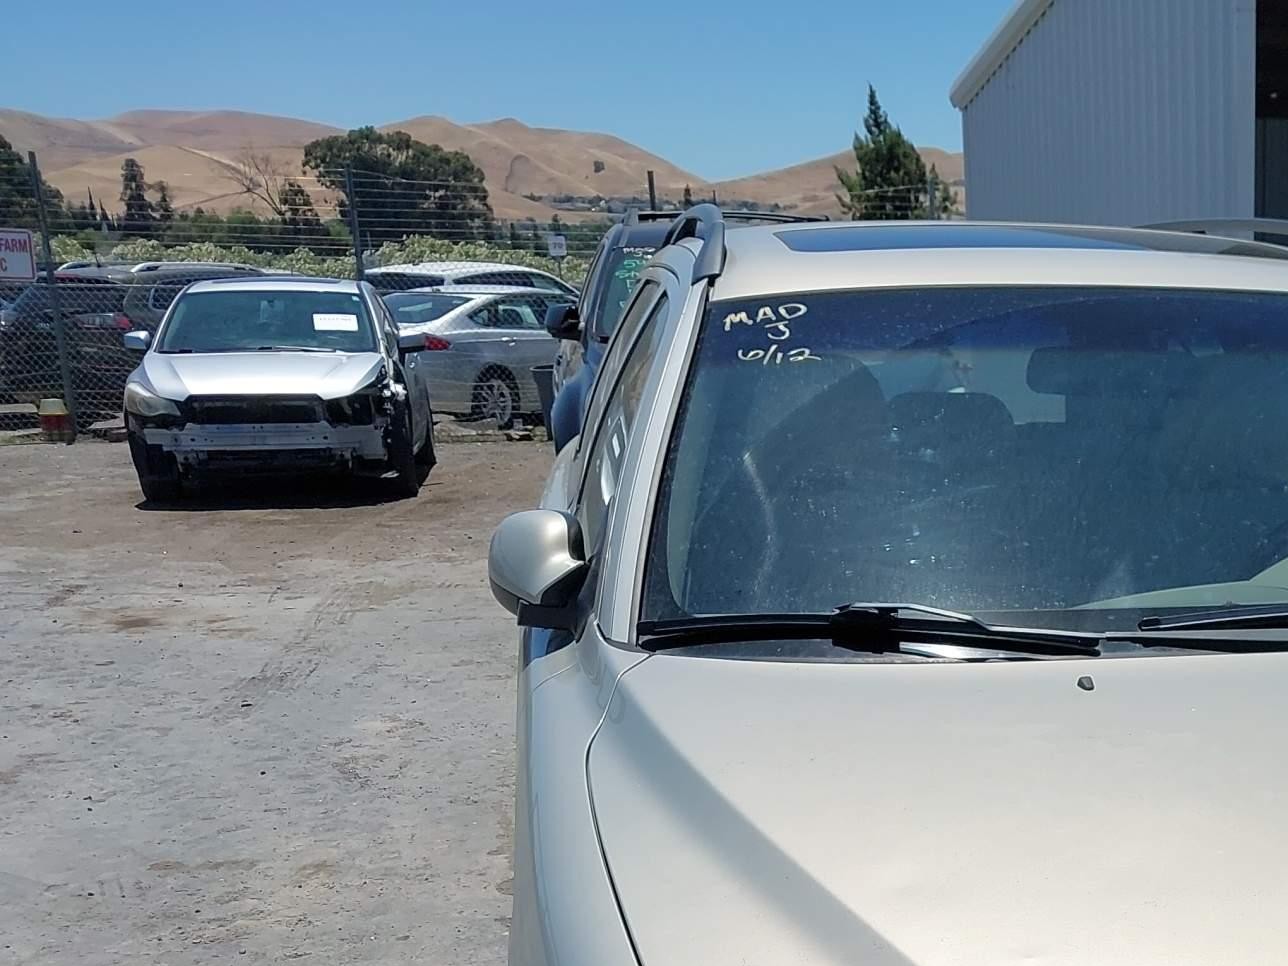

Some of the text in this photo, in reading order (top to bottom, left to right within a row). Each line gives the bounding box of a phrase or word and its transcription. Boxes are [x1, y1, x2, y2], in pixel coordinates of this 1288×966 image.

[0, 238, 28, 252] FARM
[723, 303, 808, 331] MAD
[737, 344, 822, 365] 6/12
